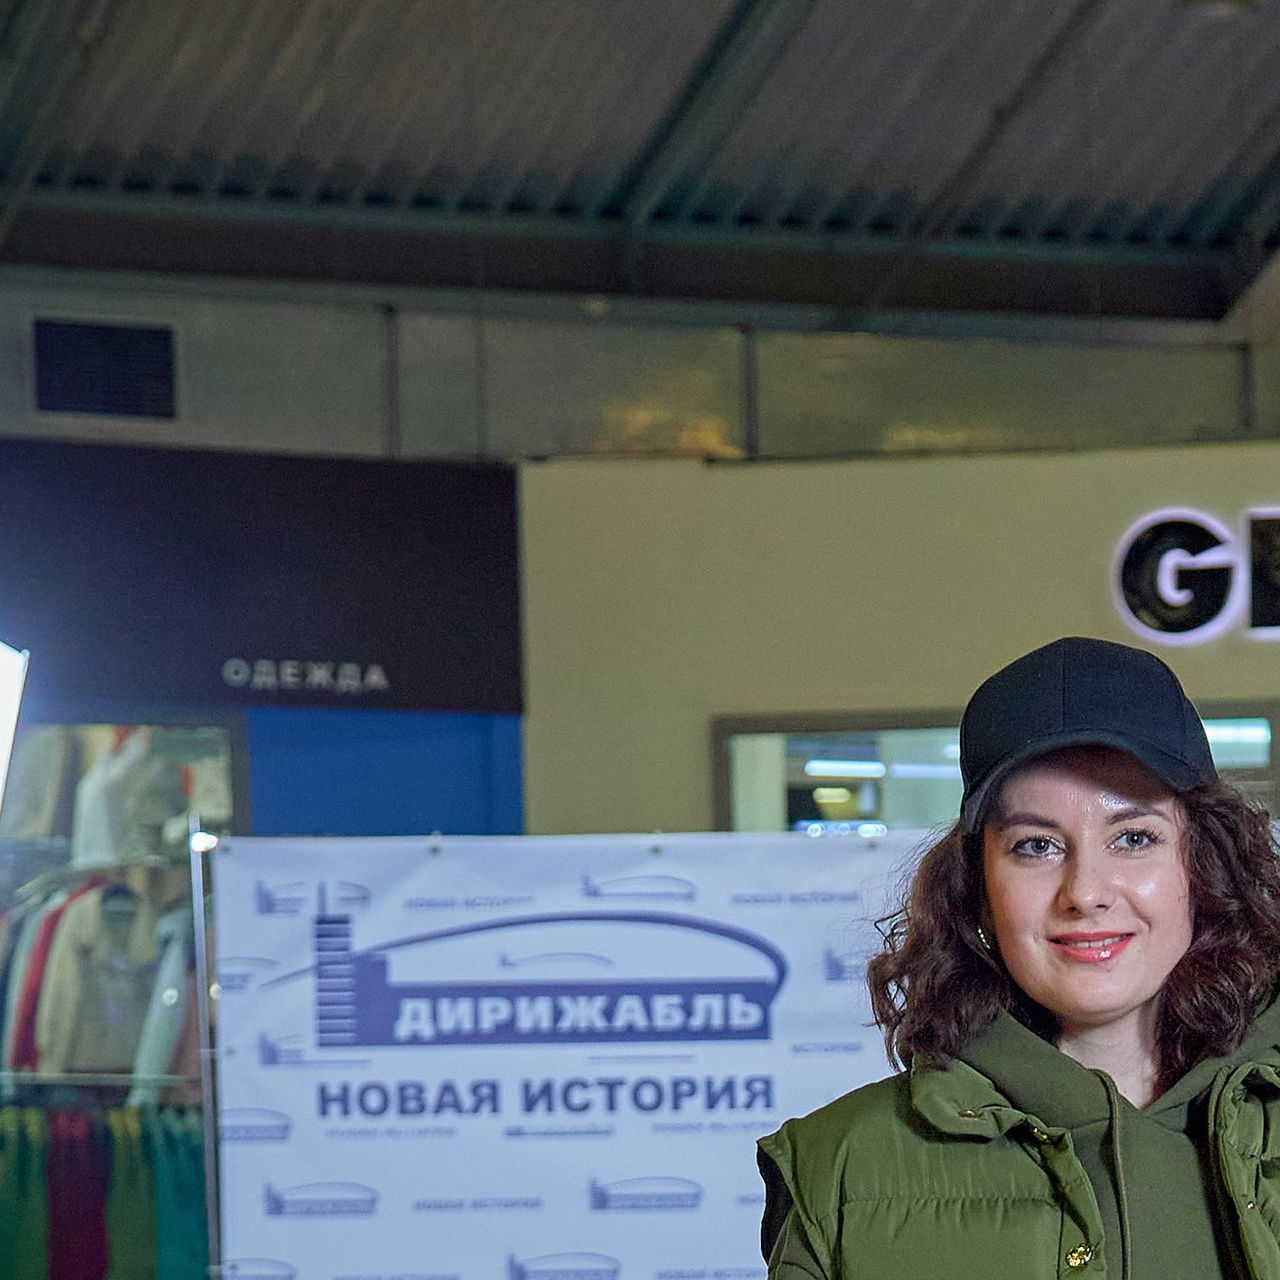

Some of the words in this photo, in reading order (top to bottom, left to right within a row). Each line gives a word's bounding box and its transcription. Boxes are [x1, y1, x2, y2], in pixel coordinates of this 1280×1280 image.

[221, 657, 388, 693] ОДЕЖДА
[394, 994, 766, 1040] ДИРИЖАБЛЬ
[316, 1077, 501, 1119] НОВАЯ
[518, 1073, 775, 1114] ИСТОРИЯ
